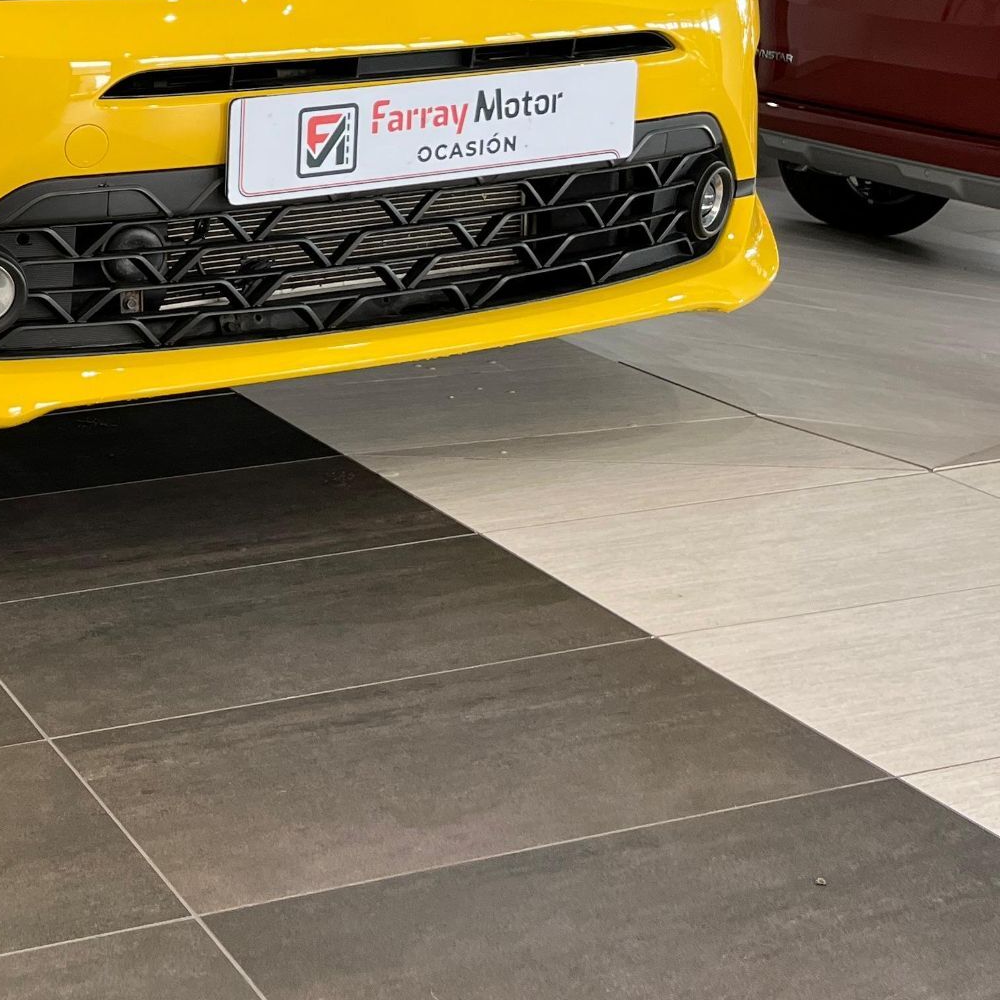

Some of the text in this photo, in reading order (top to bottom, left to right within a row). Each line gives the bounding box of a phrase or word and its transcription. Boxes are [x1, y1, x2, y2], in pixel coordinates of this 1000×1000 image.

[756, 49, 794, 64] NSTAR
[371, 87, 564, 136] Farray Motor
[416, 132, 517, 163] OCASIÓN
